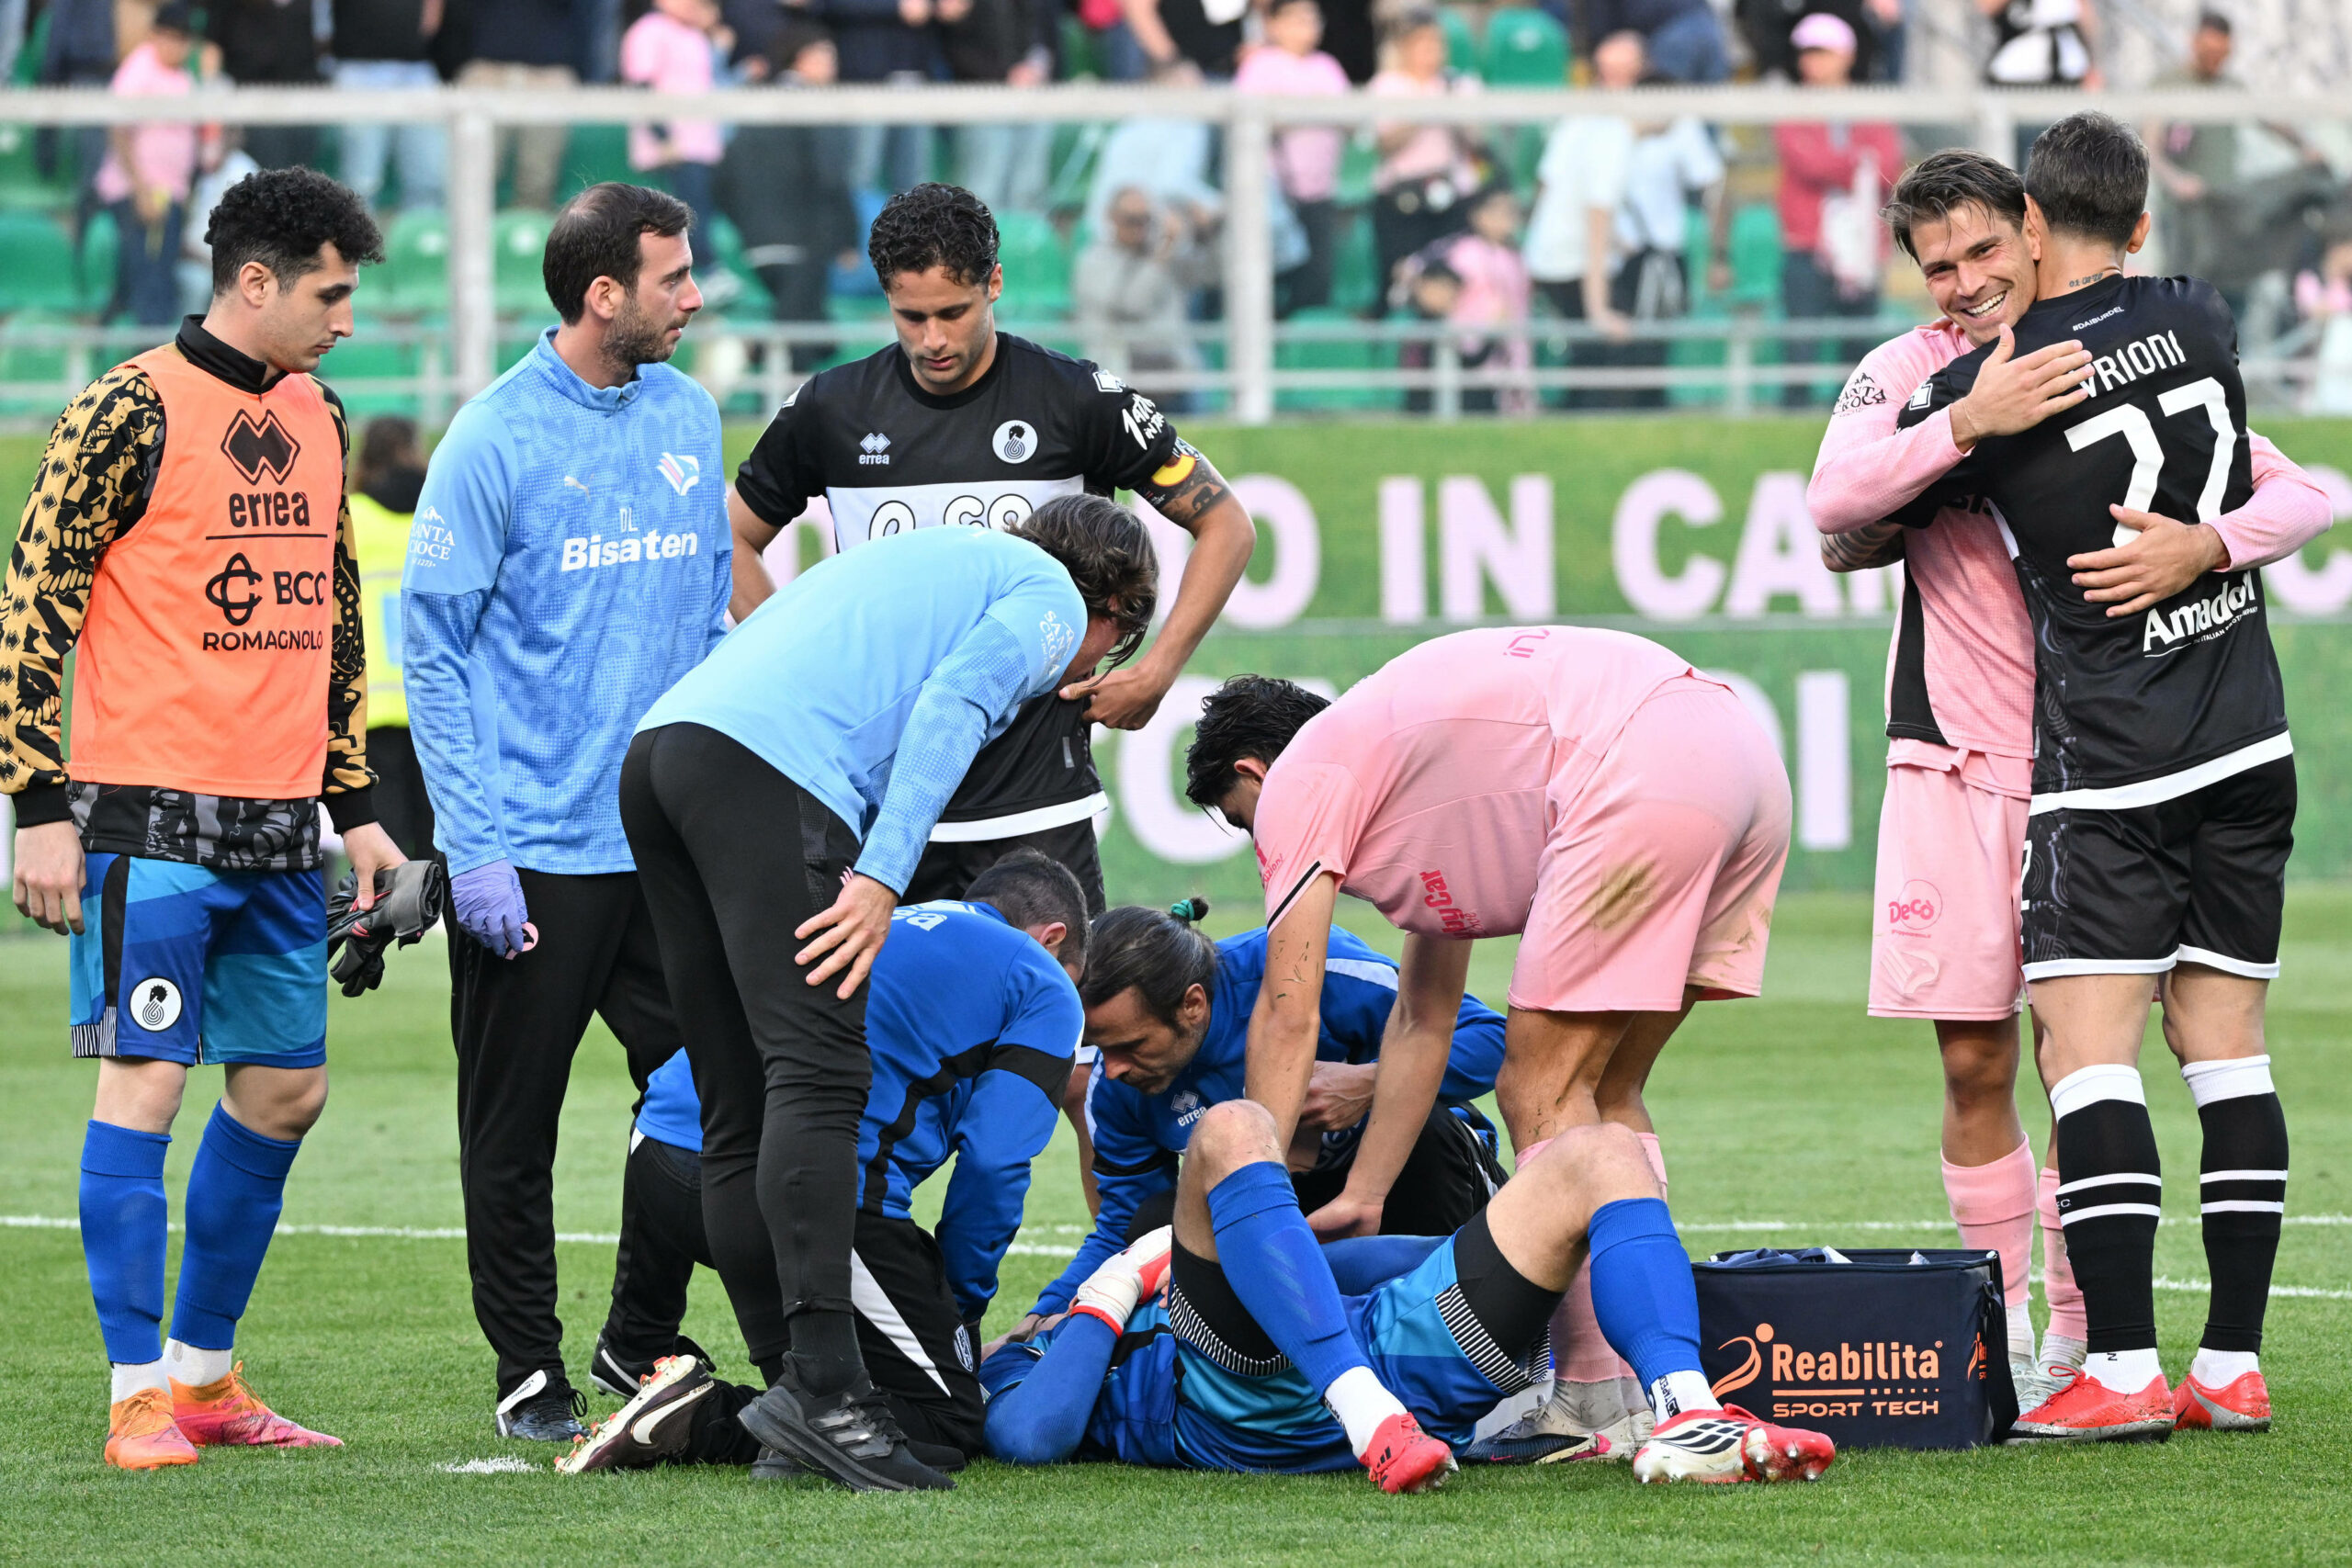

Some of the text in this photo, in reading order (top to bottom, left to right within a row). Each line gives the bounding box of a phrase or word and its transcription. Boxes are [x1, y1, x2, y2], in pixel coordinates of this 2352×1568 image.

[2073, 306, 2125, 331] #DAIBURDEL
[2064, 377, 2237, 548] 77
[619, 507, 639, 533] DL
[560, 529, 698, 572] Bisaten
[1379, 471, 1556, 626] IN
[273, 570, 327, 605] BCC
[202, 629, 323, 652] ROMAGNOLO
[1771, 1341, 1939, 1382] Reabilita
[1772, 1400, 1939, 1418] SPORT TECH
